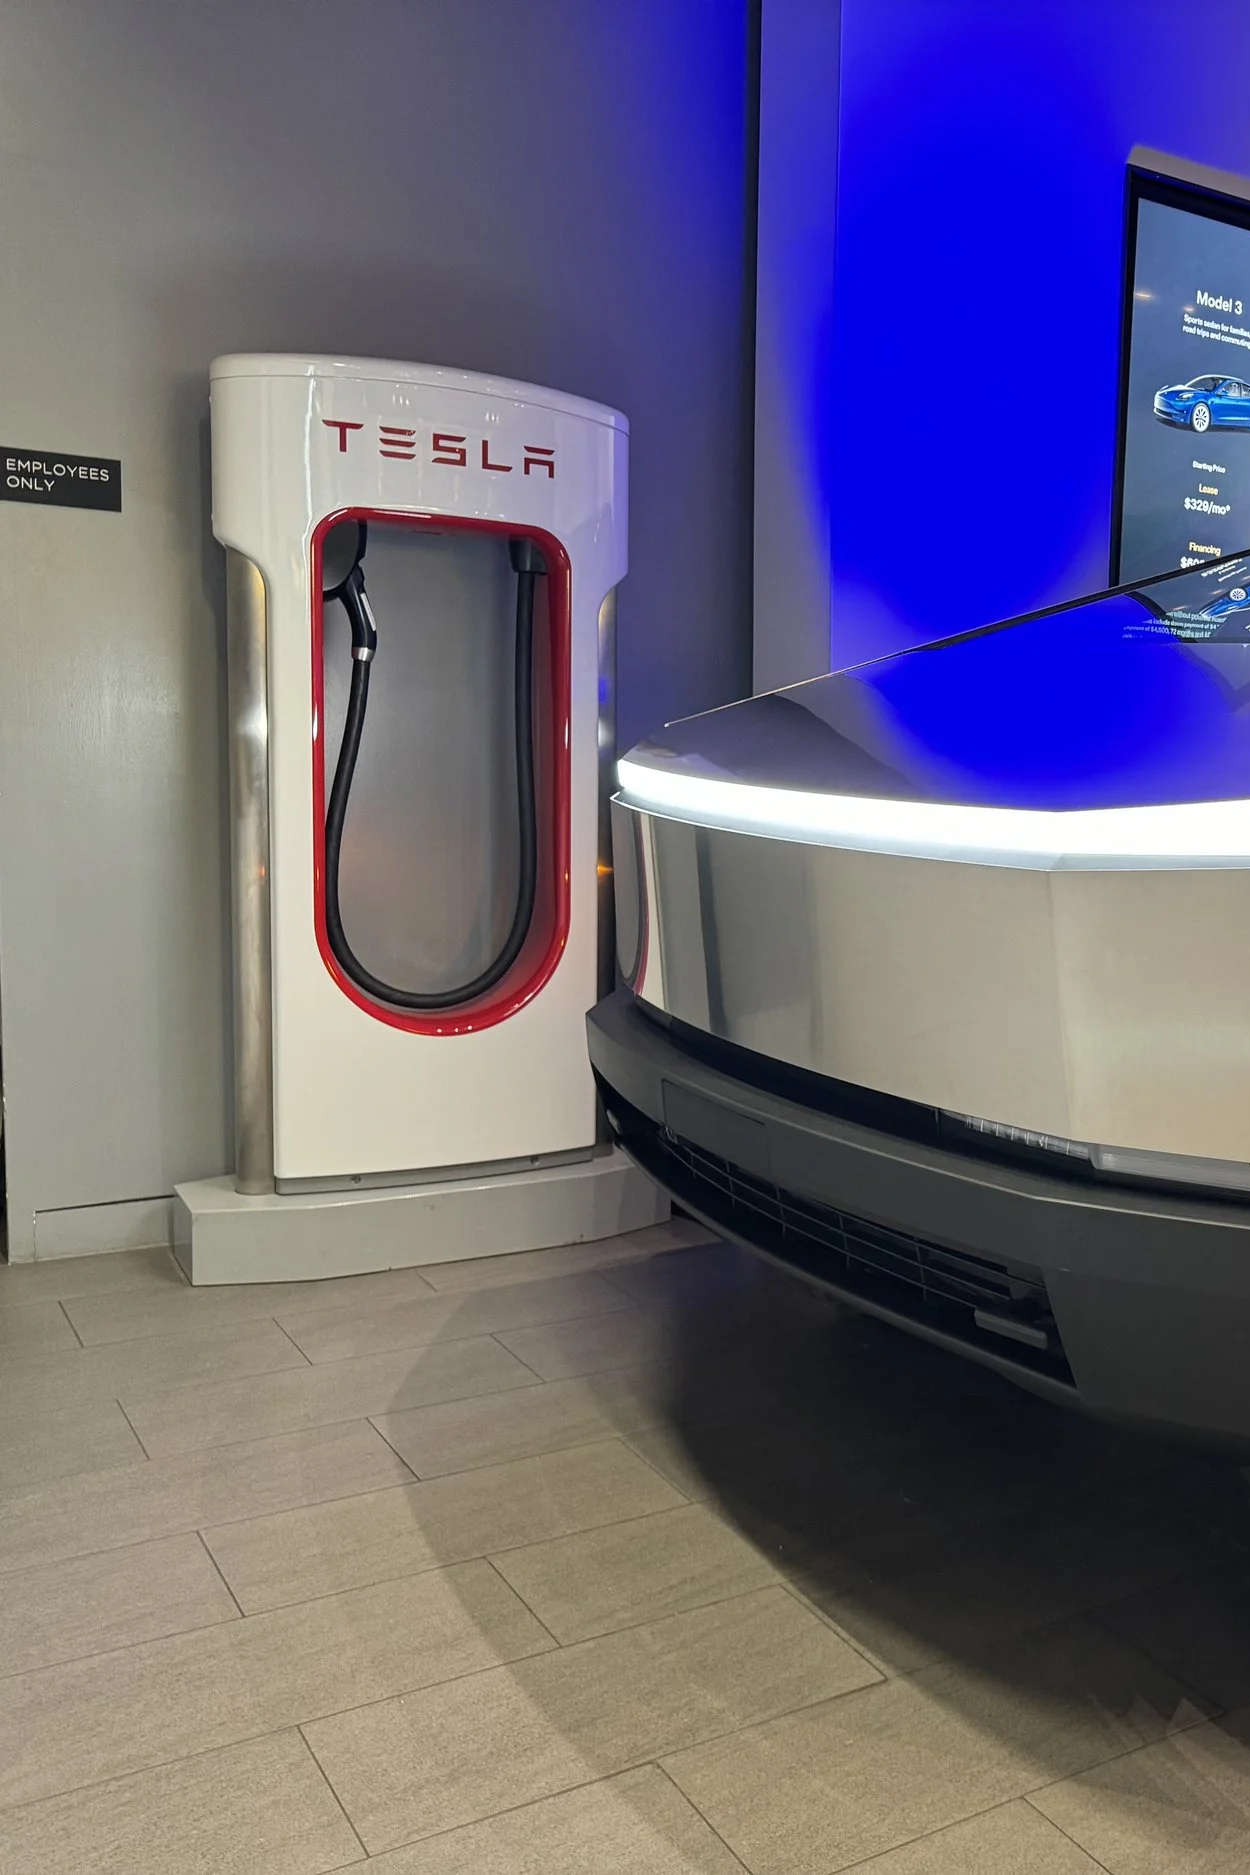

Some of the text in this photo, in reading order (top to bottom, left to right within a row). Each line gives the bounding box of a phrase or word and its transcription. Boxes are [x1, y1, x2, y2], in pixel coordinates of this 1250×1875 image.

[1196, 290, 1243, 315] Model 3
[1183, 313, 1203, 325] Sports
[1203, 320, 1220, 330] sedan
[1221, 323, 1229, 332] for
[1183, 325, 1196, 335] road
[1196, 327, 1210, 338] trips
[1210, 331, 1221, 341] and
[321, 419, 556, 479] TESLA
[6, 457, 110, 482] EMPLOYEES
[1192, 460, 1226, 473] Starting Price
[6, 475, 55, 492] ONLY
[1198, 483, 1219, 496] Lease
[1188, 541, 1221, 557] Financing
